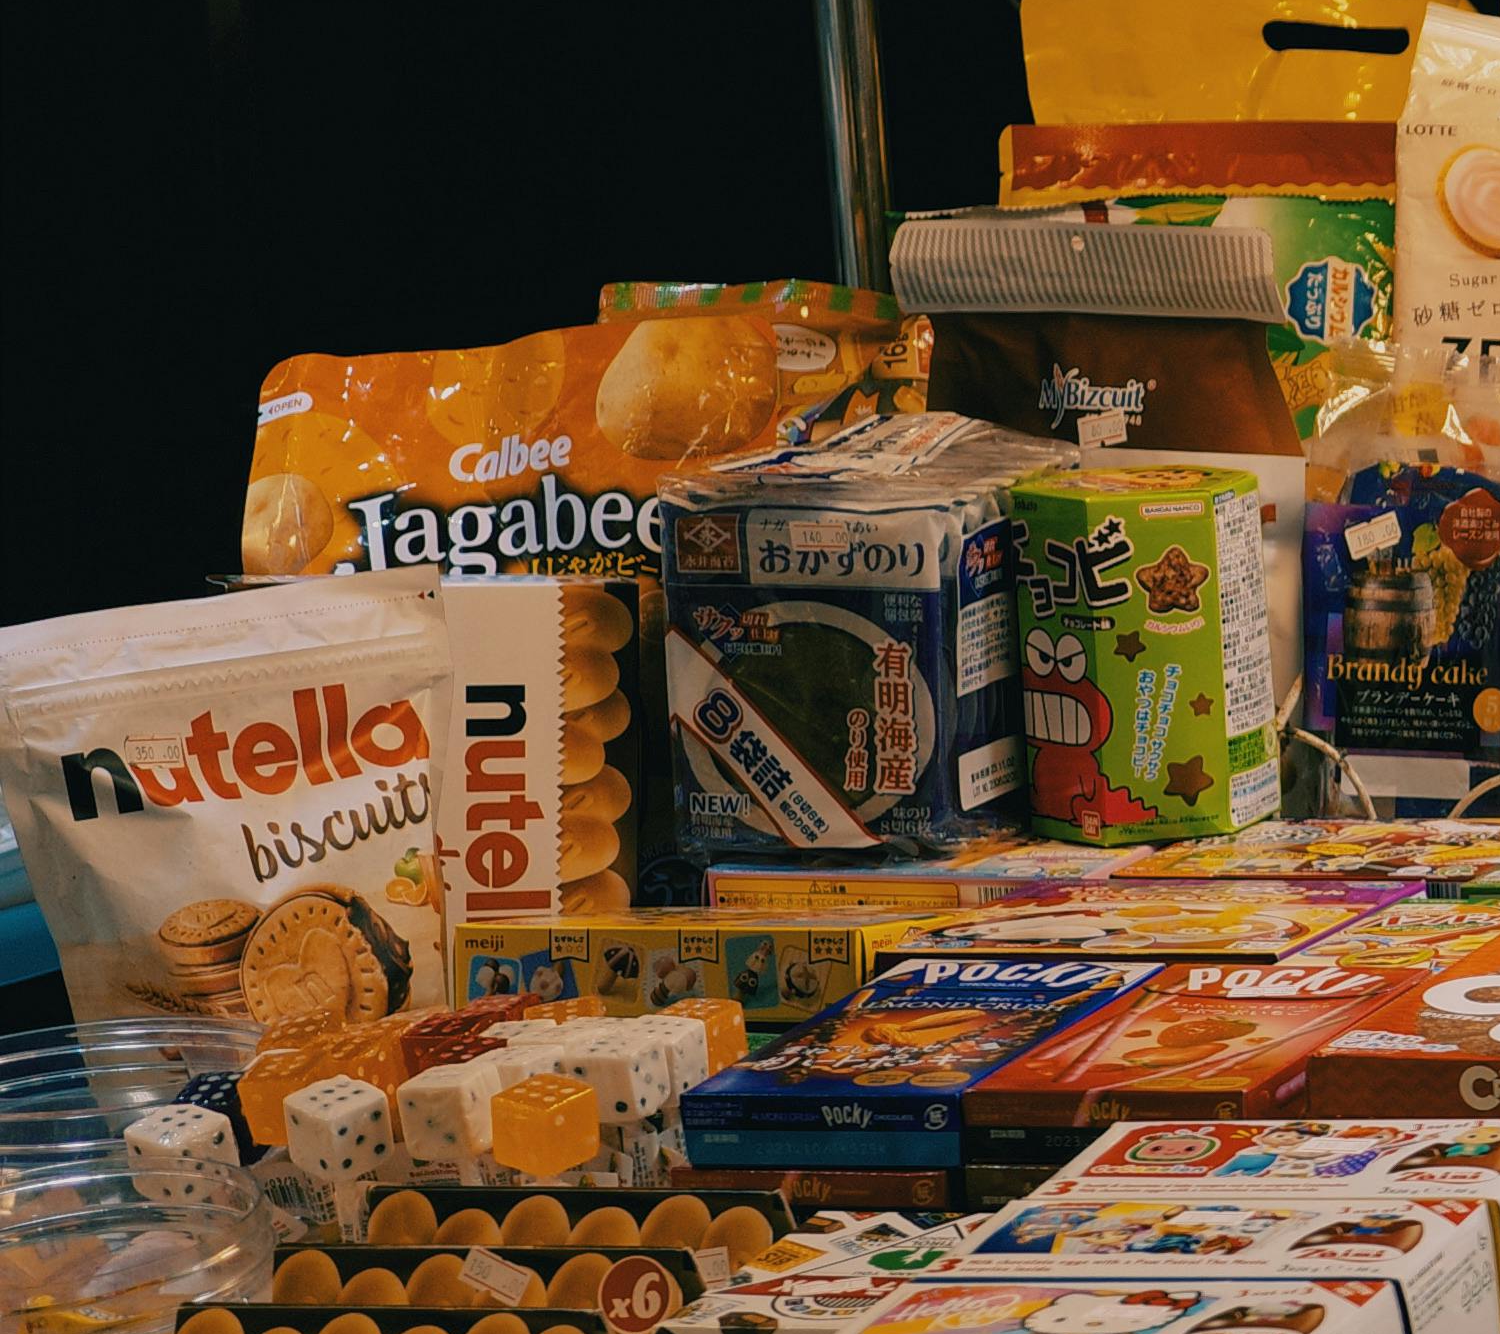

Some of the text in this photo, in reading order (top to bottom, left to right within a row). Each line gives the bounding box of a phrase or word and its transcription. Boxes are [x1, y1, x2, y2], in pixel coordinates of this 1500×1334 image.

[1406, 122, 1458, 138] LOTTE
[1448, 271, 1500, 291] Sugar
[448, 434, 573, 484] Calbee
[1326, 651, 1488, 691] Brandy cake
[1356, 690, 1460, 704] ブランデーケーキ
[875, 642, 915, 794] 有明海産
[690, 794, 750, 816] NEW!
[463, 932, 506, 951] meiji
[822, 1100, 875, 1128] Pocky
